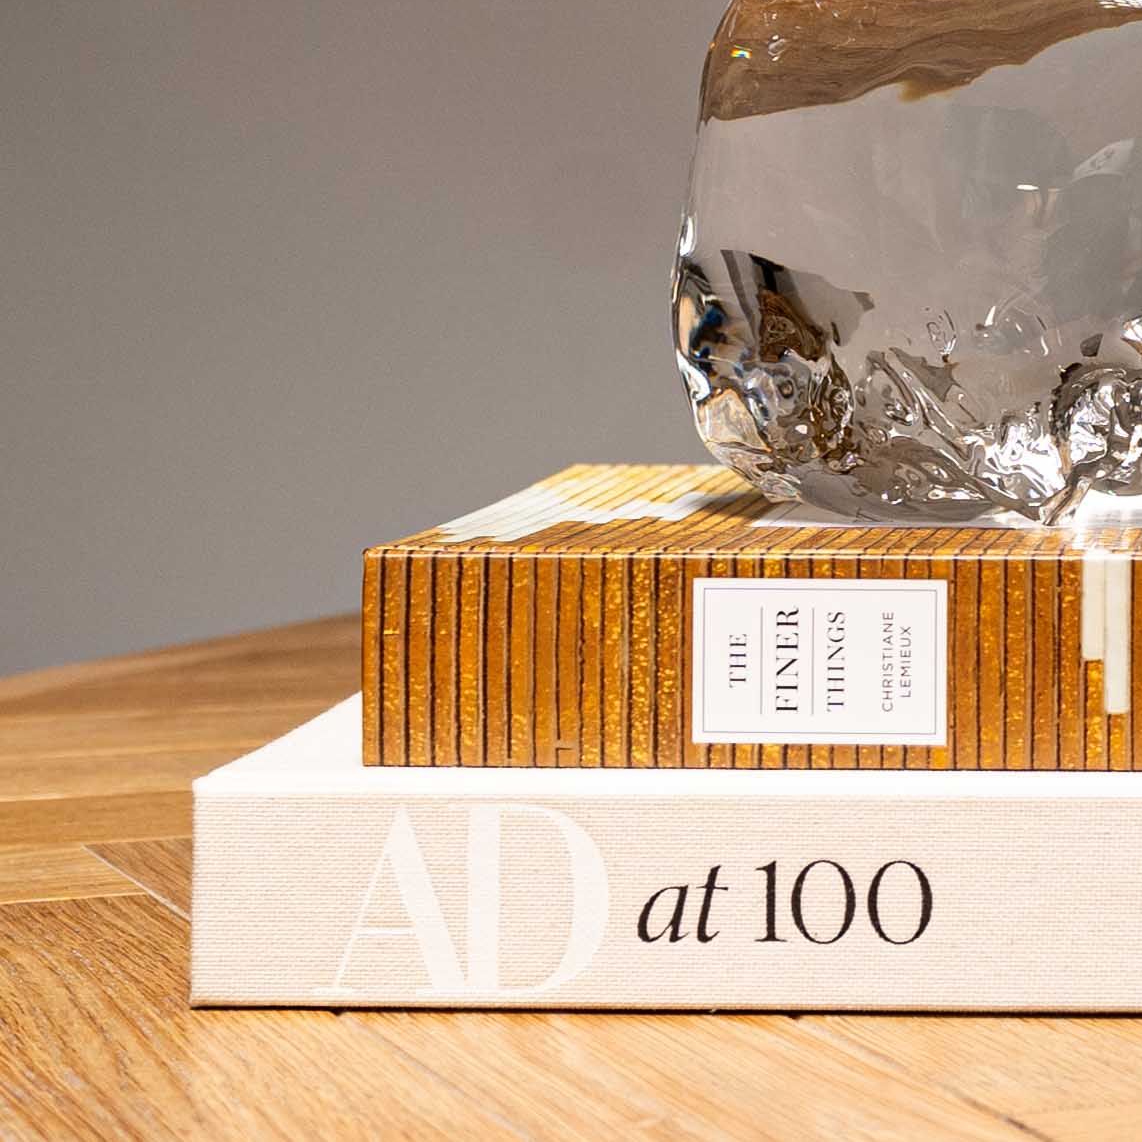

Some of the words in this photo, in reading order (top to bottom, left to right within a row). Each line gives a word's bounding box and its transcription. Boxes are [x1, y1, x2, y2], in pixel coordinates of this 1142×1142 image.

[729, 633, 747, 689] THE
[775, 607, 799, 714] FINER
[826, 610, 845, 713] THINGS
[881, 610, 894, 713] CHRISTIANE
[899, 625, 911, 699] LEMIEUX
[313, 802, 609, 998] AD
[636, 864, 729, 943] at
[755, 860, 933, 944] 100
